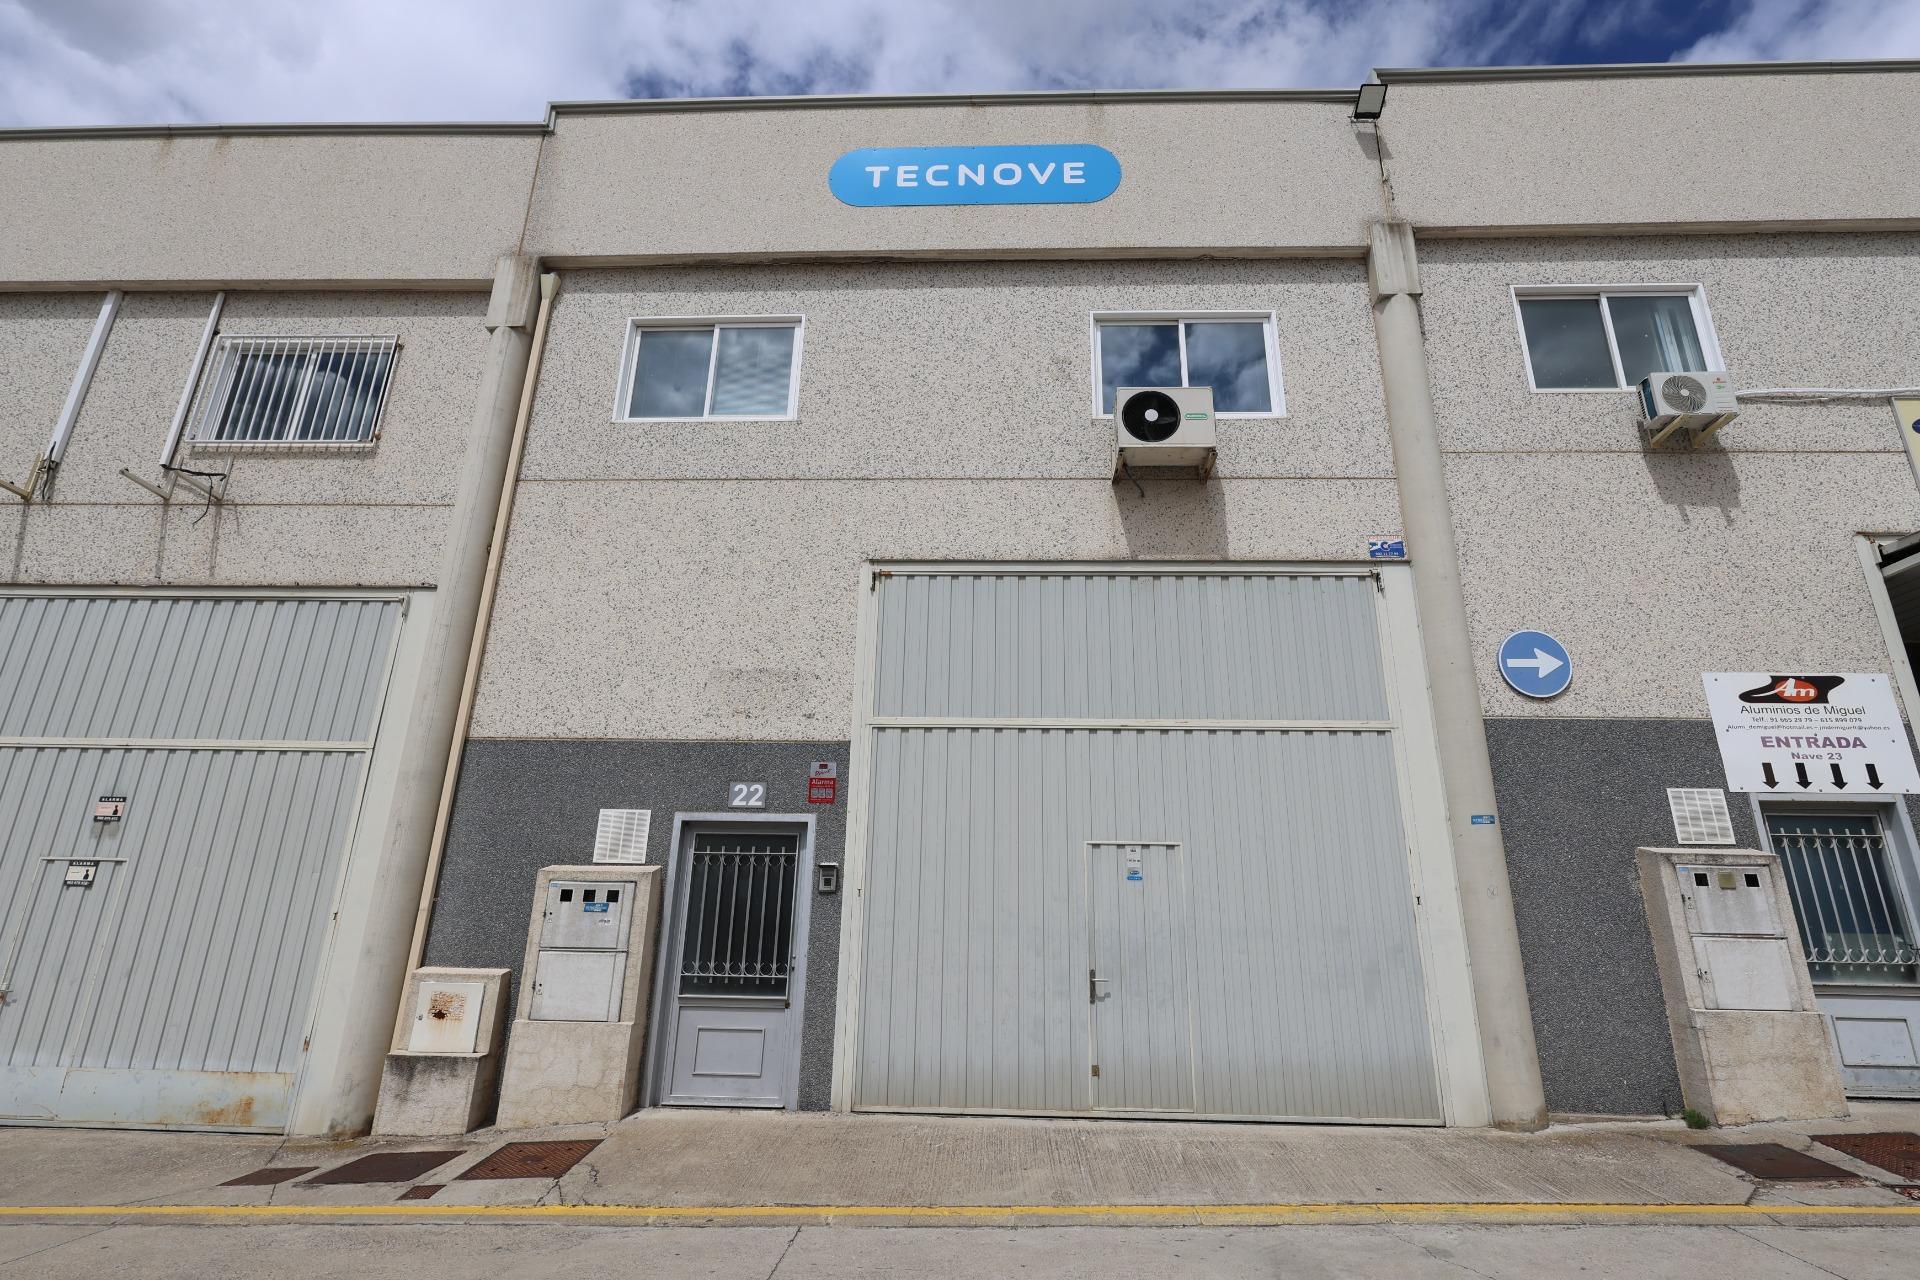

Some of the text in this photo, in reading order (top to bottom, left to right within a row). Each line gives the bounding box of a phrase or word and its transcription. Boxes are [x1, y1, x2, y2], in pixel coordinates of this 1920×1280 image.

[865, 162, 1086, 188] TECNOVE
[1740, 705, 1866, 717] Aluminios de Miguel
[1760, 736, 1867, 749] ENTRADA
[1791, 752, 1843, 761] Nave 23
[732, 784, 763, 806] 22
